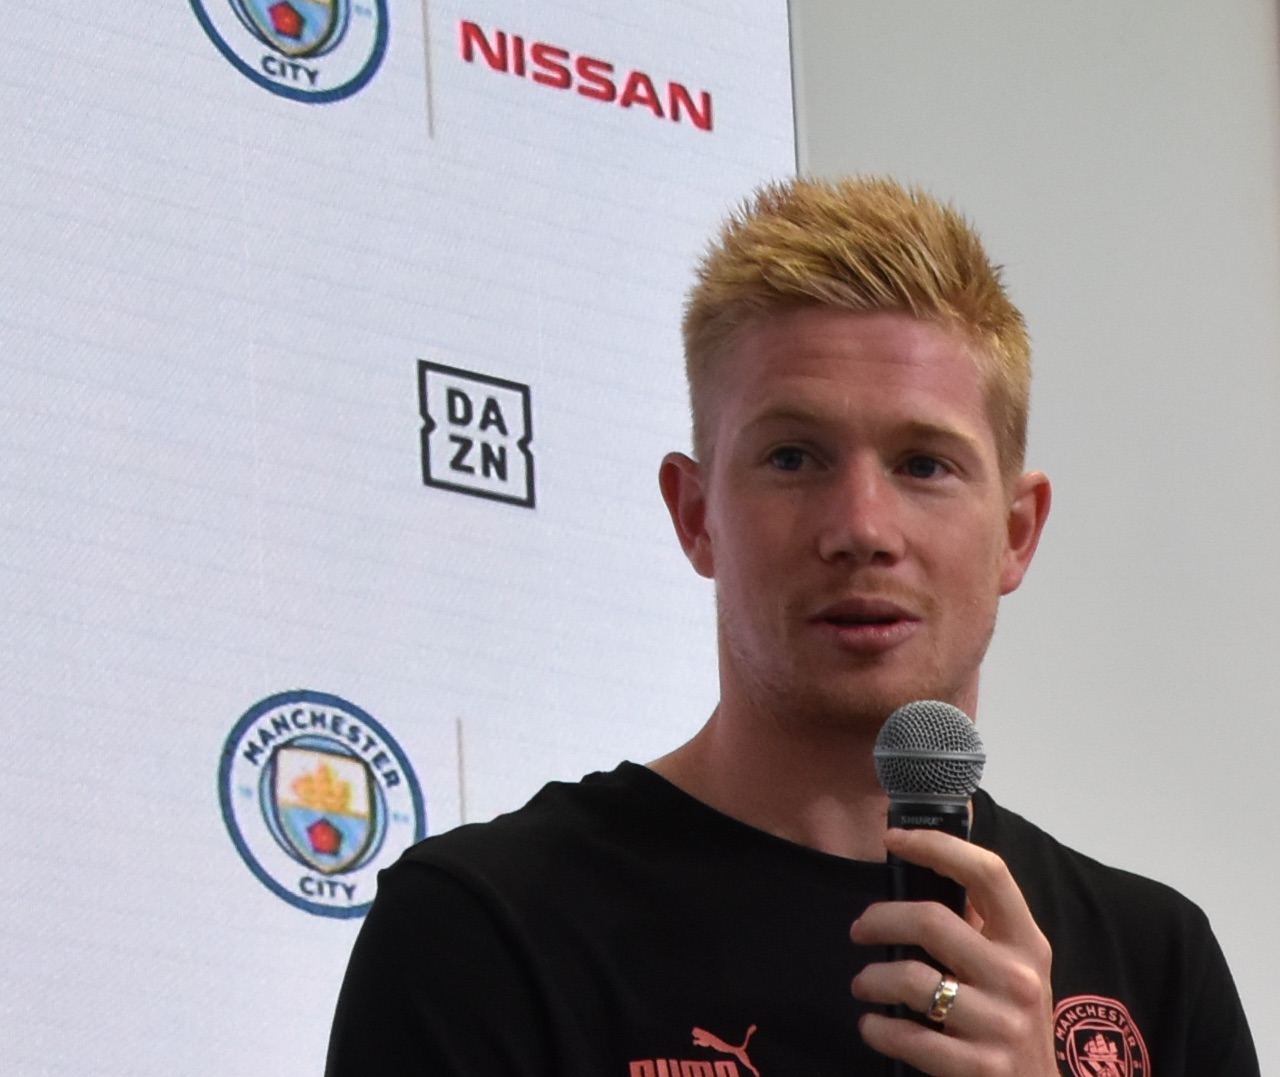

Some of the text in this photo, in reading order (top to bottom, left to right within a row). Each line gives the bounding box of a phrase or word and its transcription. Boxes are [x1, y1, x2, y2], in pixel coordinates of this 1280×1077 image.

[262, 54, 320, 86] CITY
[458, 20, 713, 132] NISSAN
[243, 708, 401, 789] MANCHESTER
[299, 876, 357, 900] CITY
[1055, 1004, 1137, 1047] MANCHESTER
